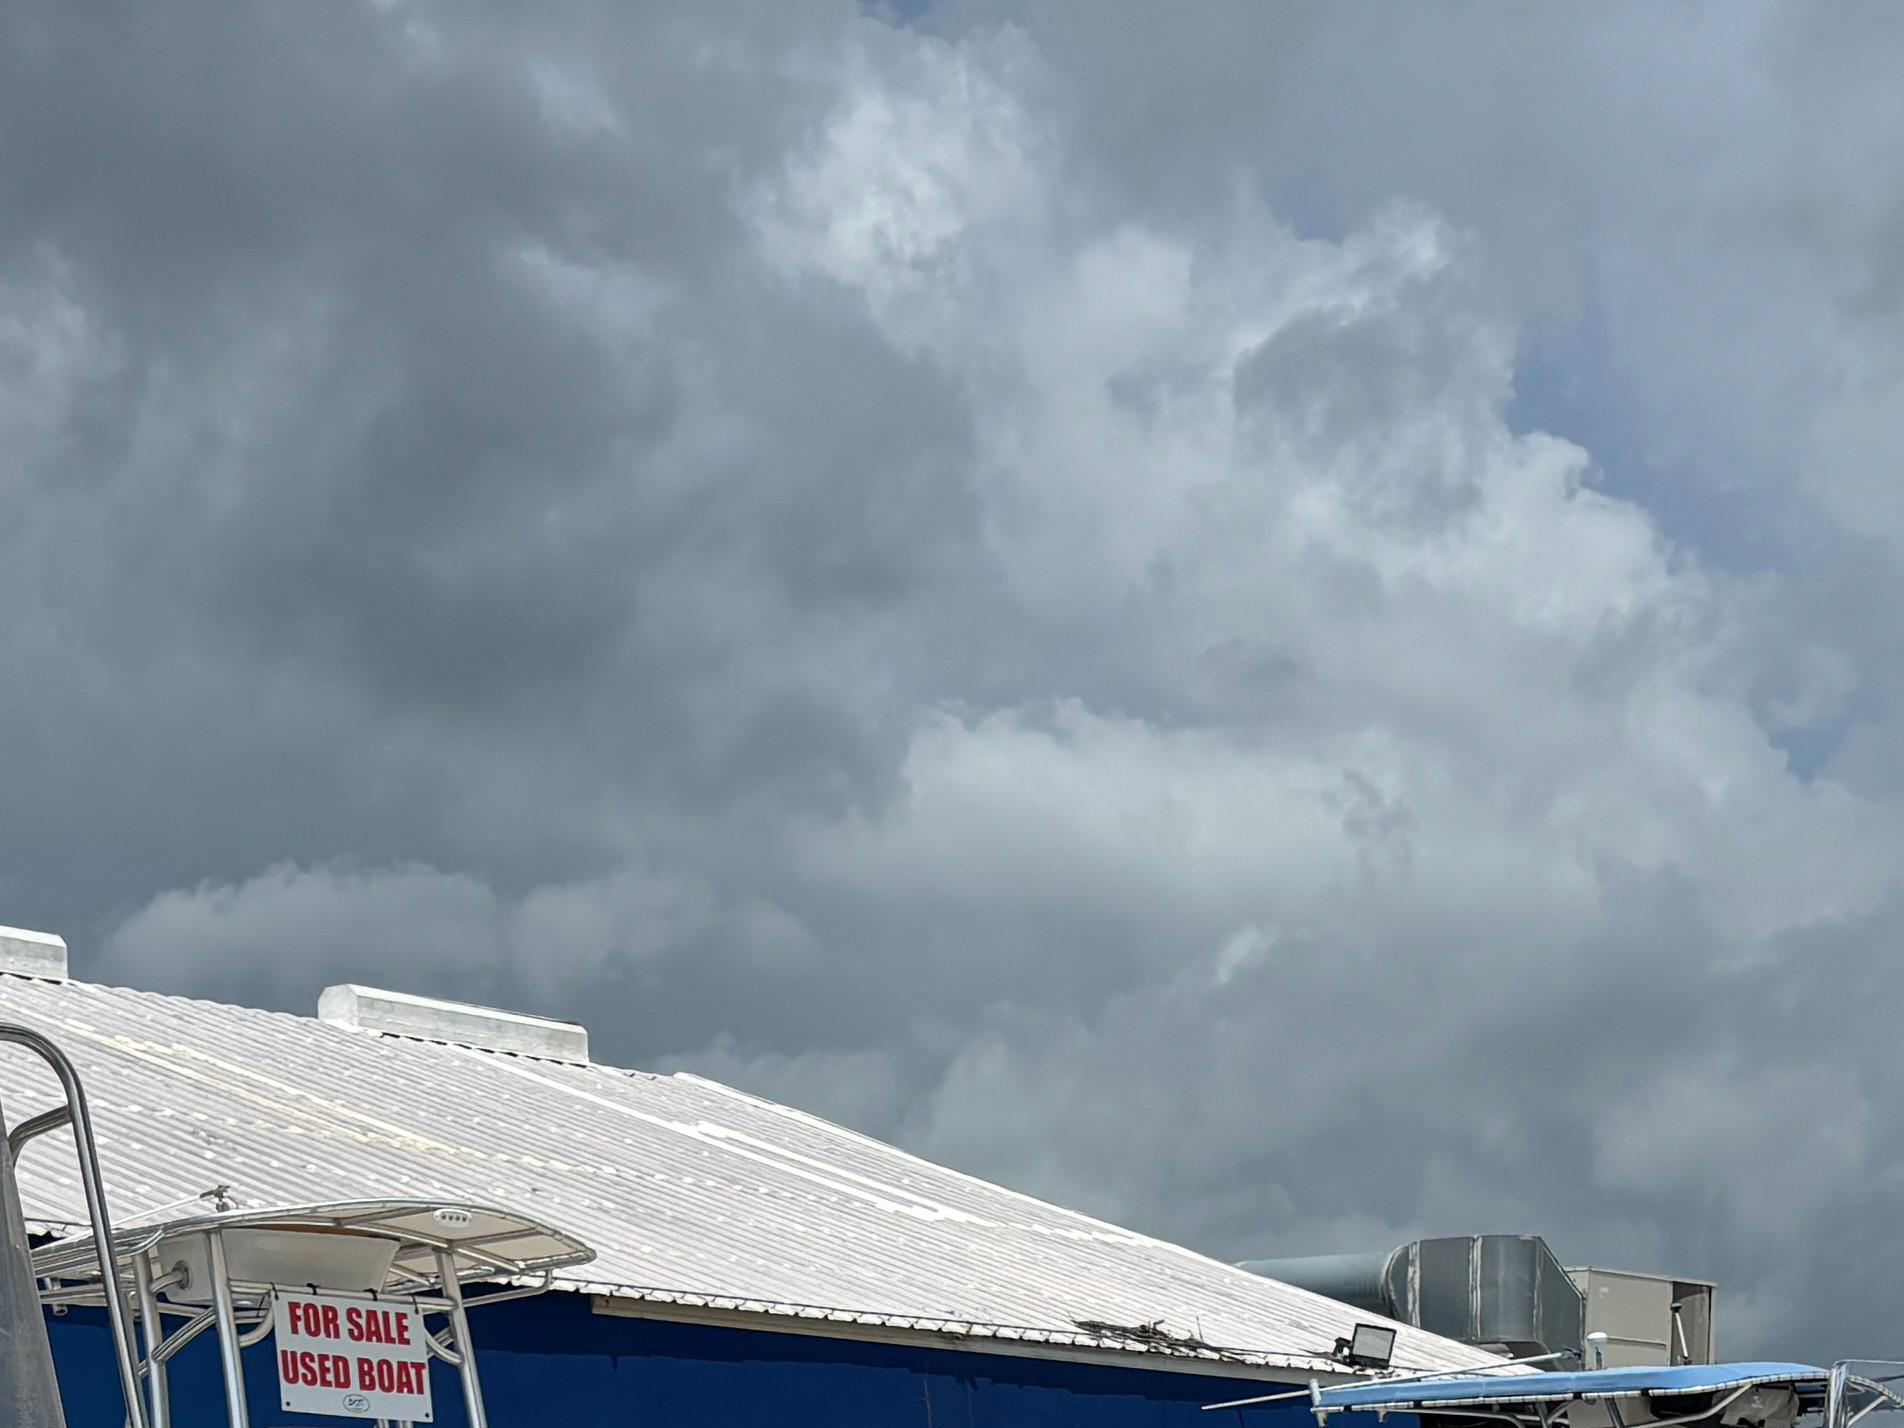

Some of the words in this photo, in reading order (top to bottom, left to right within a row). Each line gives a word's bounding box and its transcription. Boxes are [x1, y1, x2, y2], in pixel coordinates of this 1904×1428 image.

[288, 1301, 341, 1339] FOR
[346, 1307, 411, 1346] SALE
[280, 1350, 352, 1389] USED
[357, 1357, 427, 1395] BOAT
